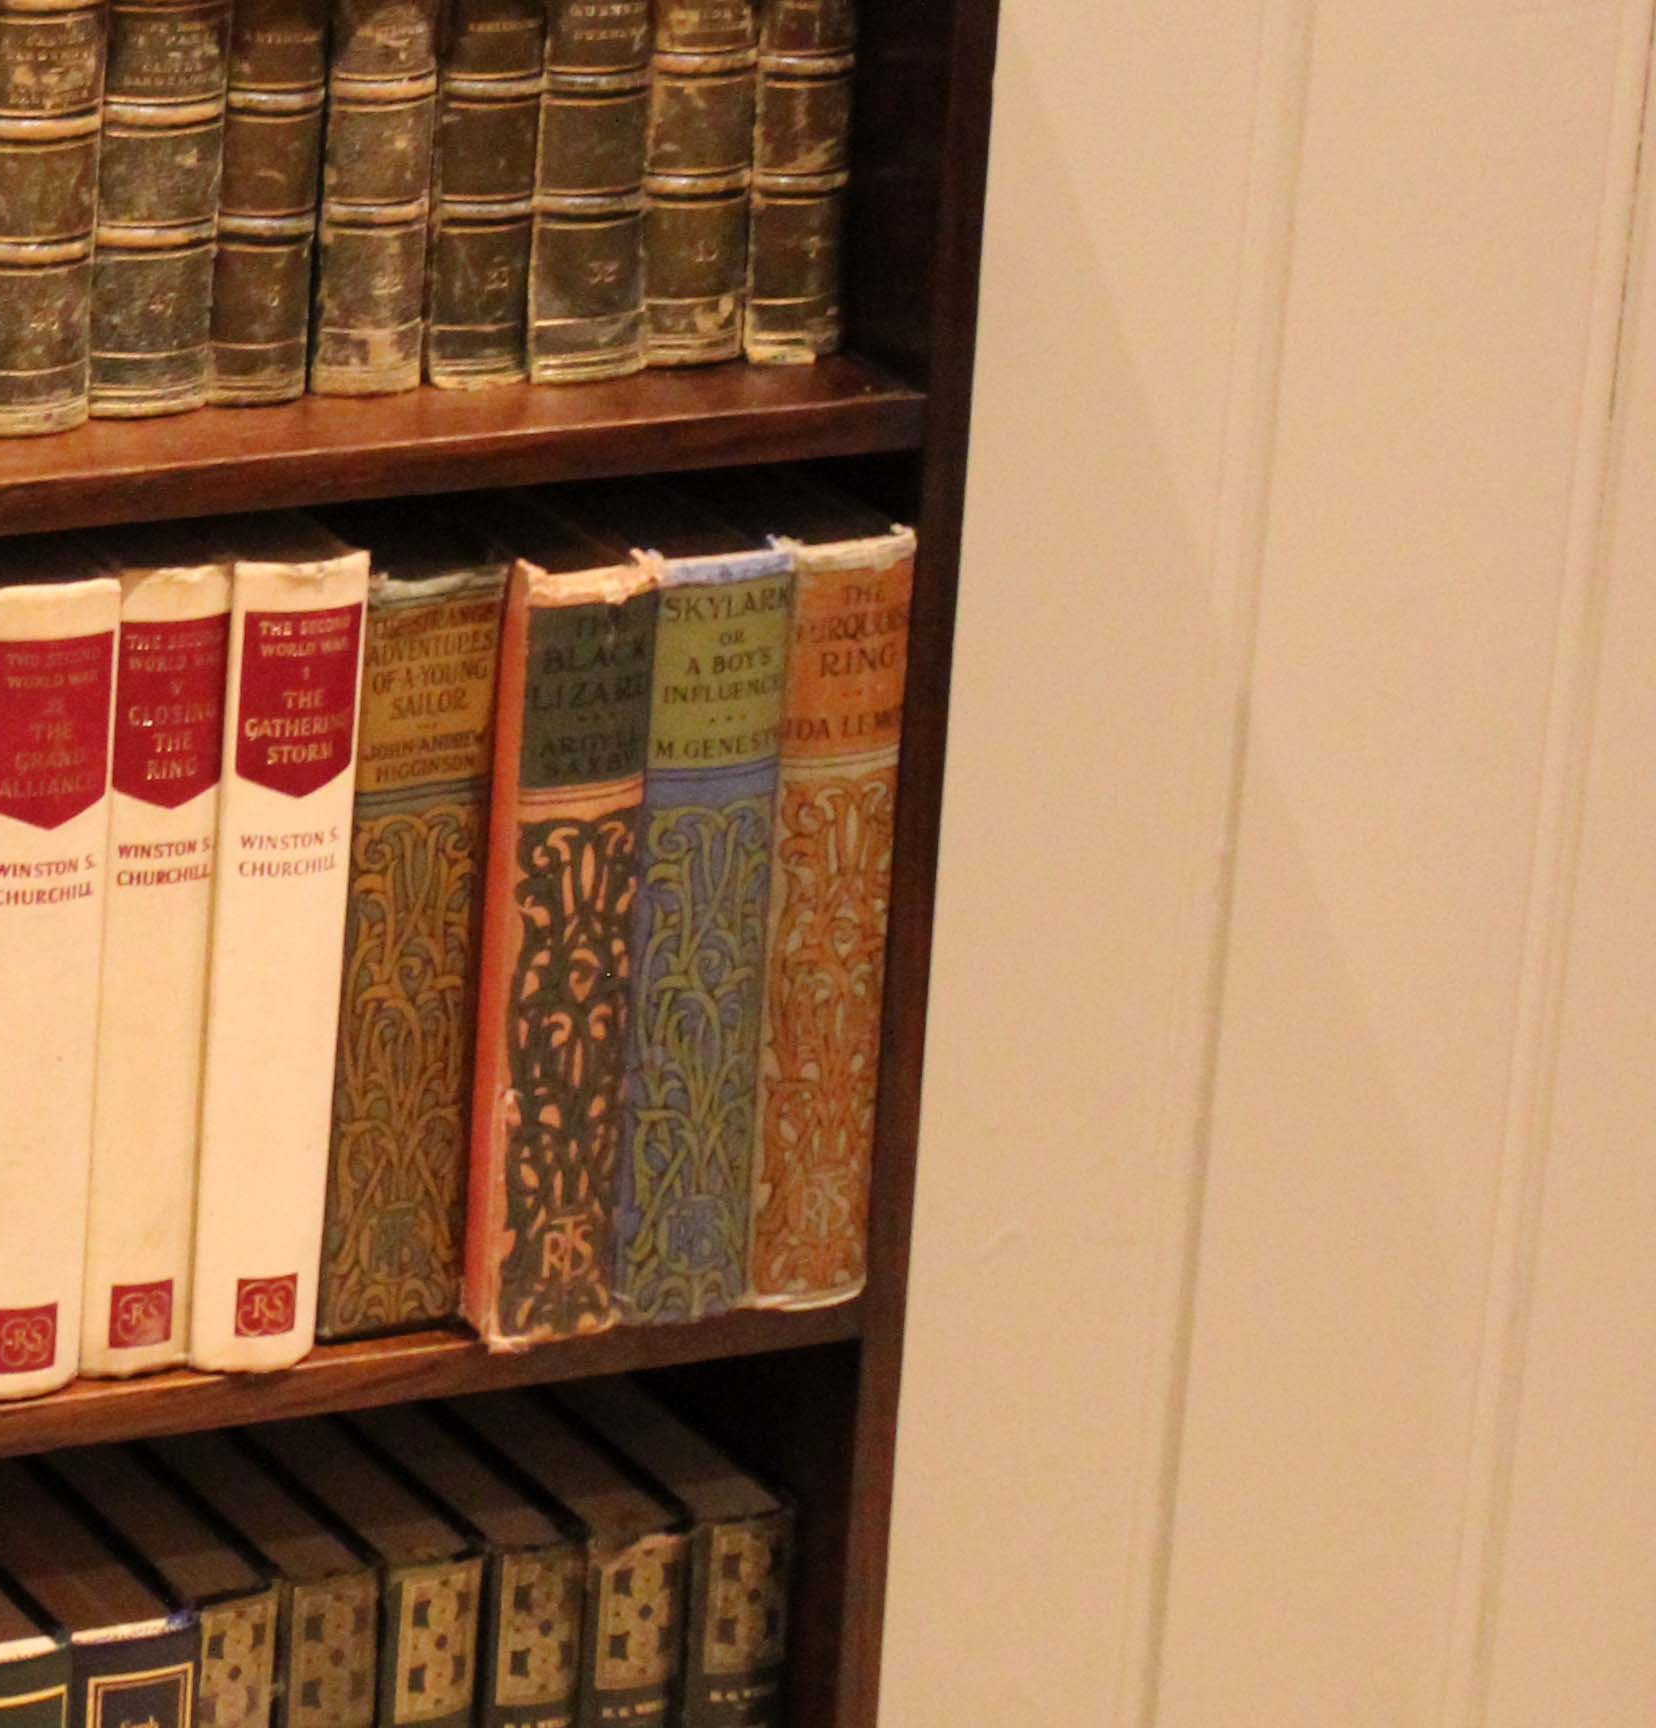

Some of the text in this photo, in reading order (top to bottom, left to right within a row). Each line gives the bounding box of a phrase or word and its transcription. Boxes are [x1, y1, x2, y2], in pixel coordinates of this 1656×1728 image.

[664, 582, 790, 623] SKYLARK
[844, 584, 887, 605] THE
[719, 631, 745, 646] OR
[686, 656, 701, 676] A
[820, 643, 897, 678] RING
[282, 689, 325, 710] THE
[391, 687, 467, 721] SAILOR
[27, 722, 73, 742] THE
[152, 731, 192, 753] THE
[266, 741, 334, 766] STORM
[146, 758, 197, 781] RING
[118, 839, 201, 859] WINSTON
[240, 831, 325, 851] WINSTON
[116, 863, 211, 887] CHURCHILL
[238, 854, 337, 878] CHURCHILL
